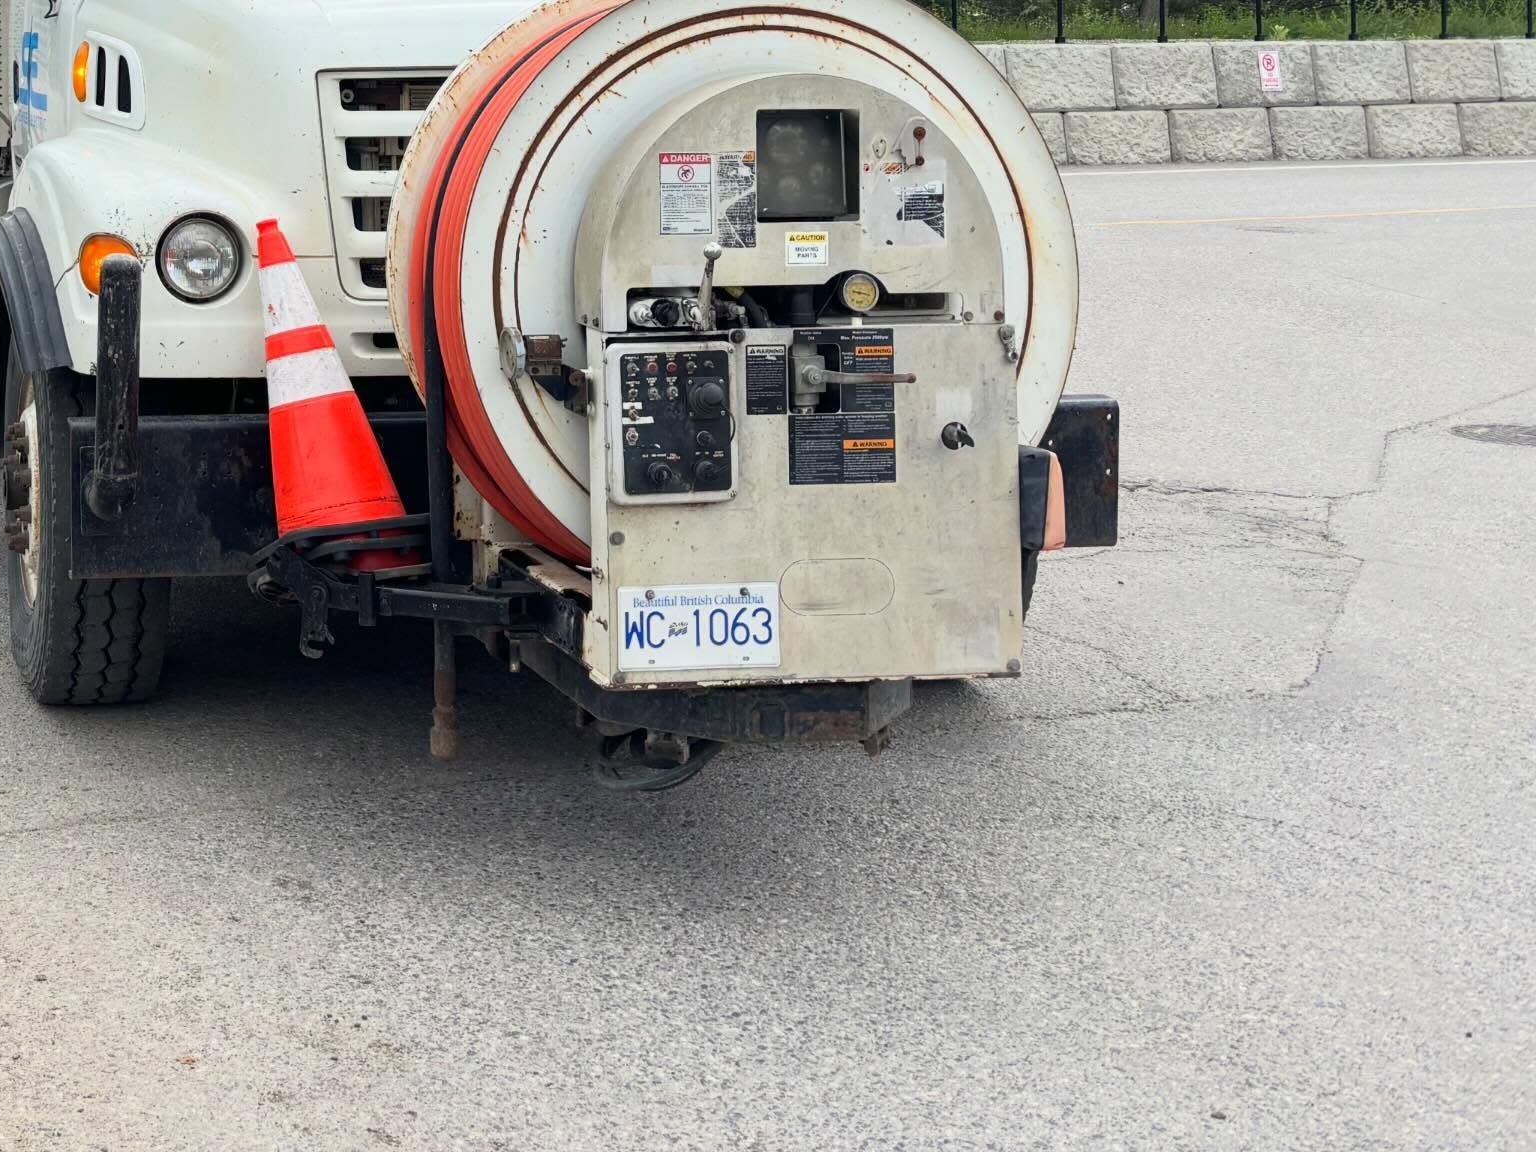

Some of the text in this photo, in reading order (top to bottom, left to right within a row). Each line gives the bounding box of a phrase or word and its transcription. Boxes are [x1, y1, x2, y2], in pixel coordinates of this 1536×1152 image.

[670, 154, 710, 163] DANGER
[633, 594, 765, 608] Beautiful British Columbia
[624, 607, 773, 650] WC 1063
